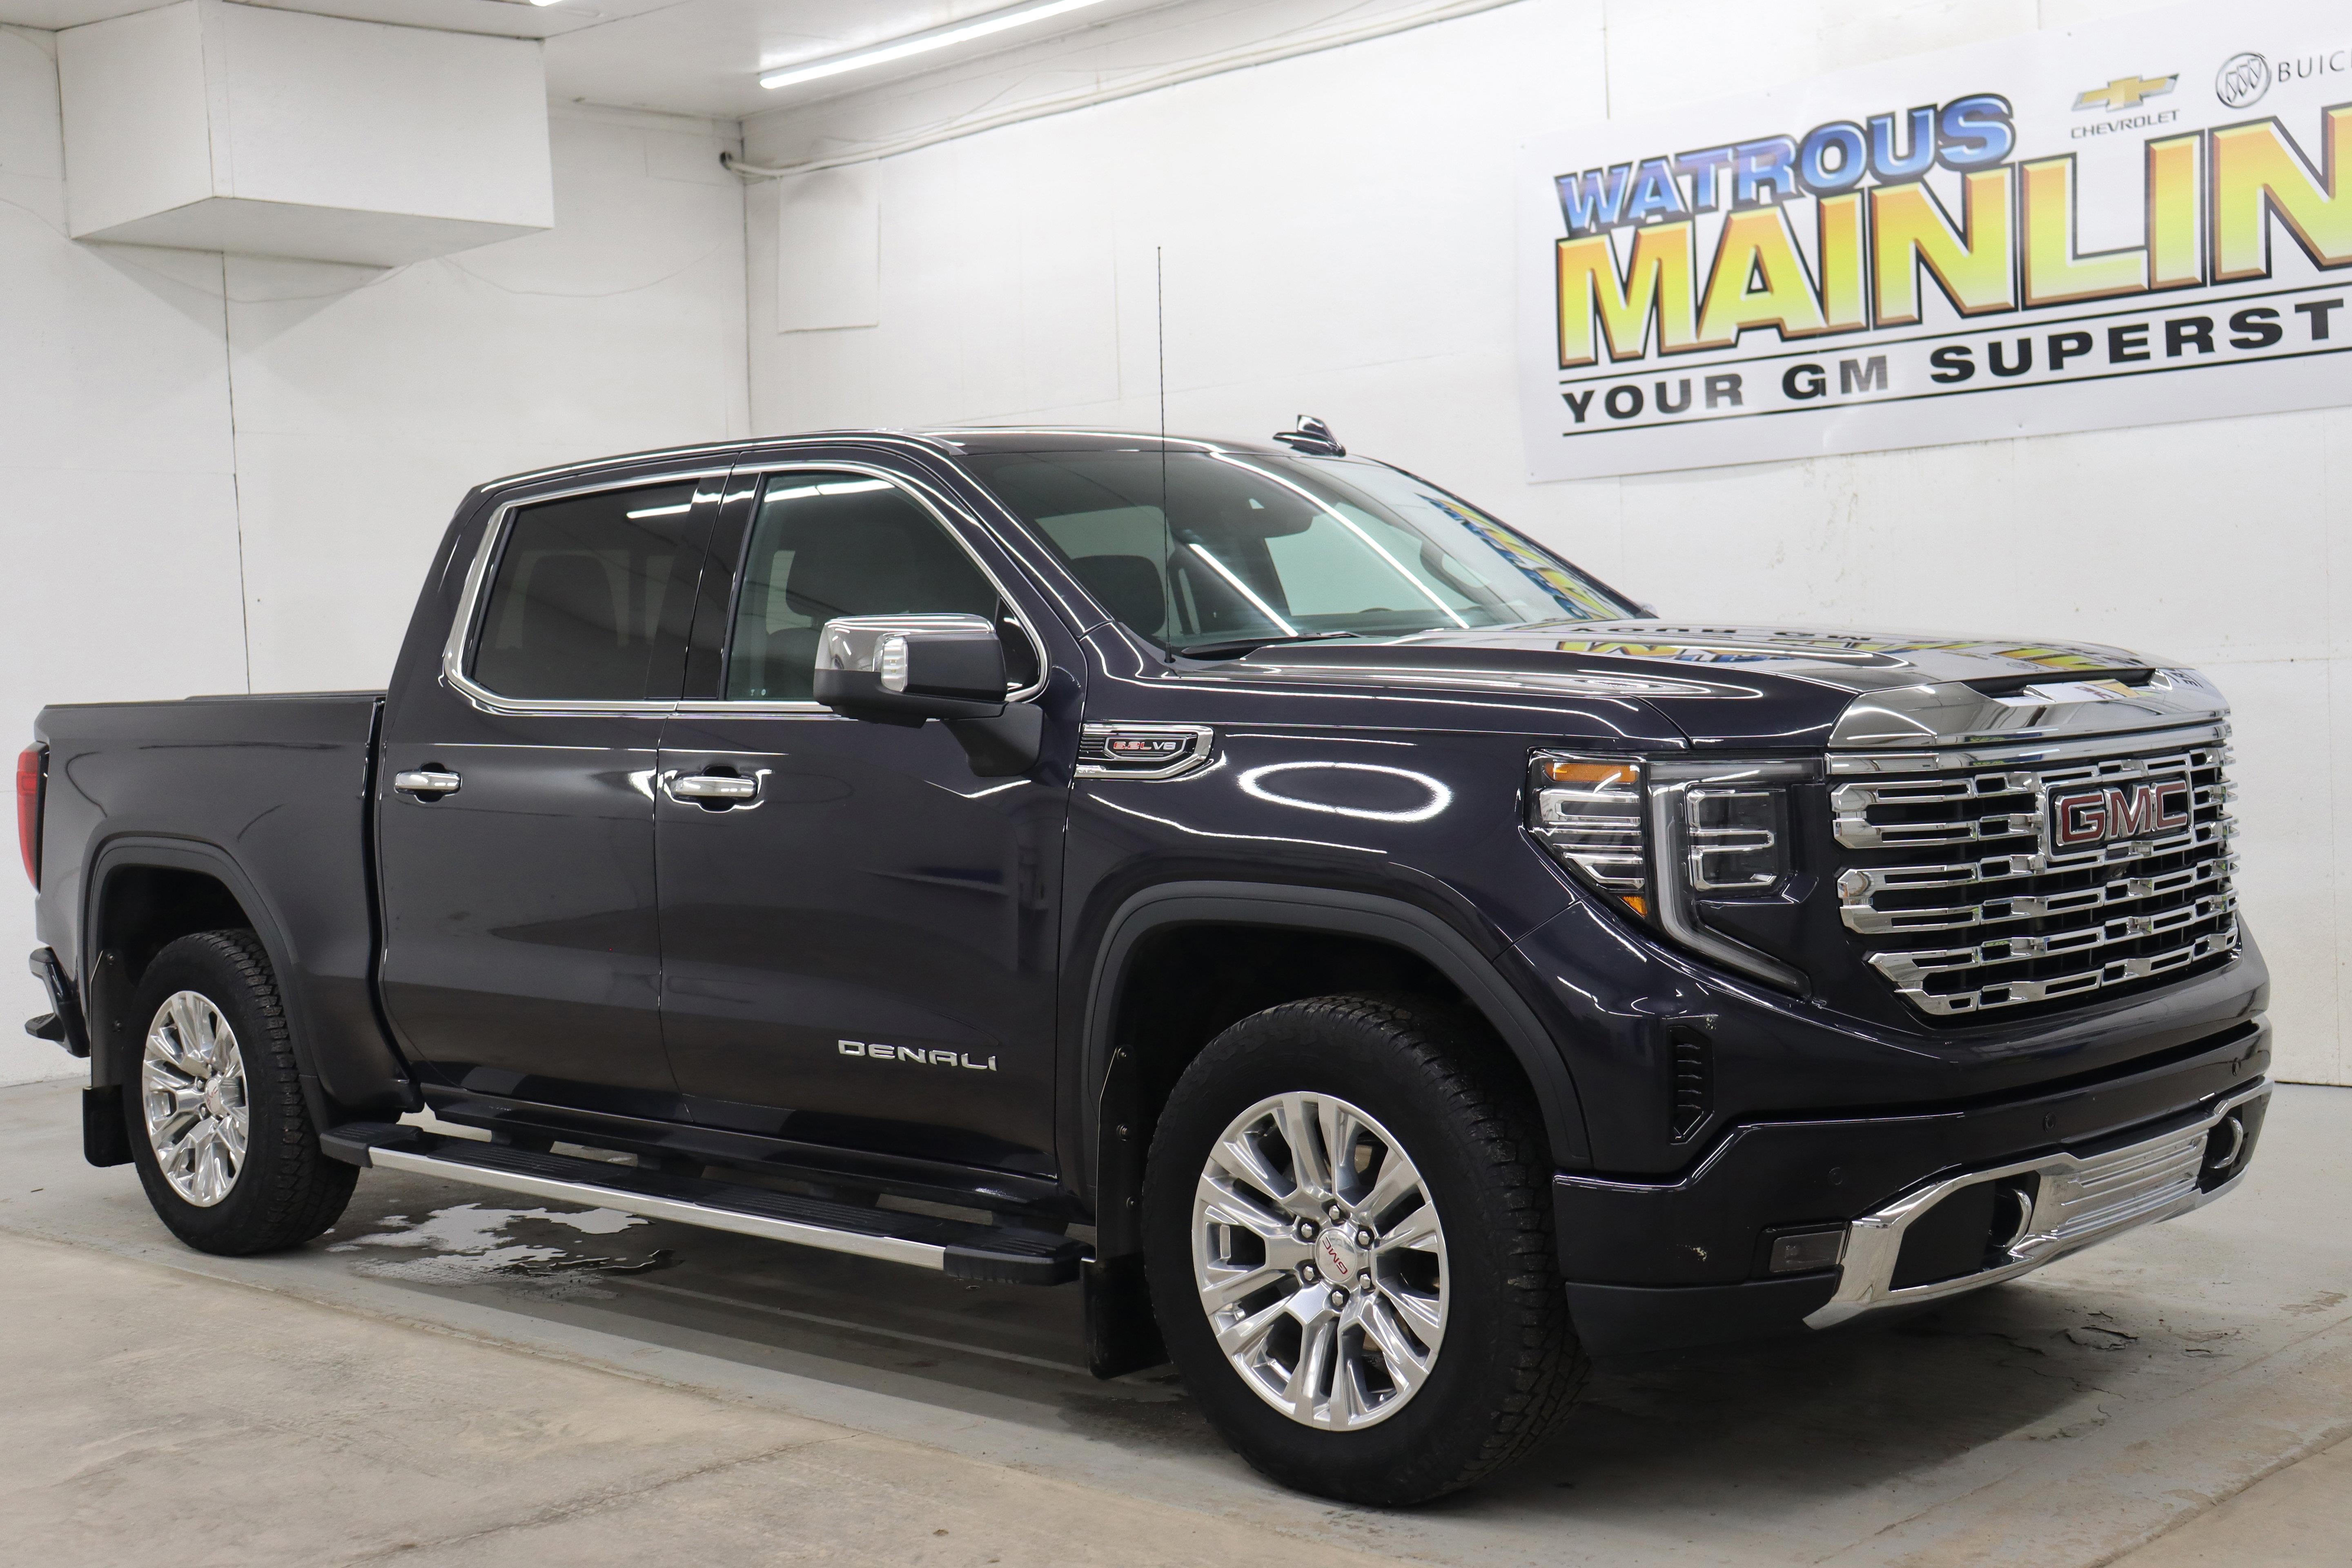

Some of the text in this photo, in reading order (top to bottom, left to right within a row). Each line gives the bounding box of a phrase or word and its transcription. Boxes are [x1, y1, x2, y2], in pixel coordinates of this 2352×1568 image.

[2278, 48, 2352, 82] BUIC
[2071, 109, 2180, 139] CHEVROLET
[1554, 93, 2016, 238] WATROUS
[1561, 298, 2344, 423] YOUR GM SUPERST
[2055, 778, 2188, 847] GMC
[838, 1040, 997, 1072] DENALI
[1322, 1236, 1348, 1274] GMC
